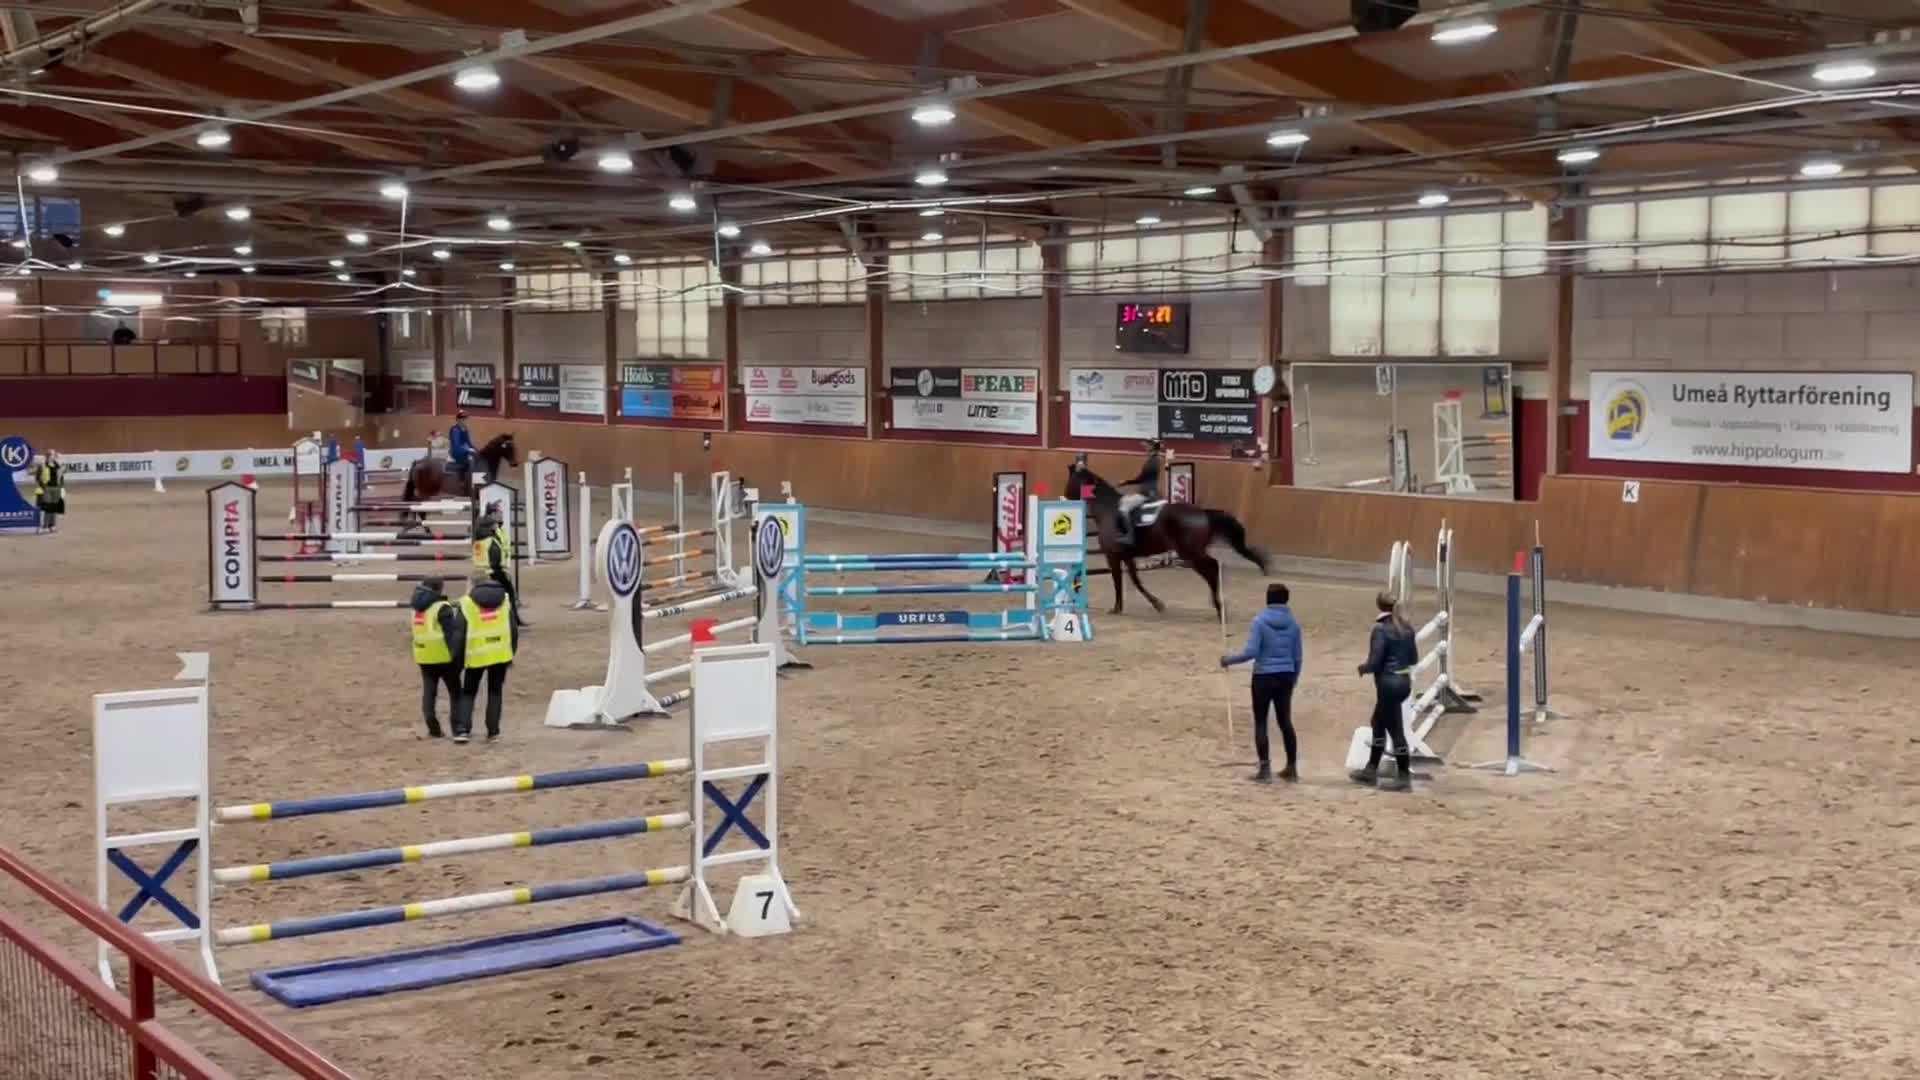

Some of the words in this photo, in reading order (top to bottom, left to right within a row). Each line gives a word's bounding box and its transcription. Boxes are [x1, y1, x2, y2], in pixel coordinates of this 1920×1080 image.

[973, 375, 1025, 393] PEAB
[1672, 382, 1728, 403] Umeå
[1733, 384, 1891, 412] Ryttarförening
[1624, 484, 1636, 499] K
[543, 470, 559, 543] COMPIA
[224, 499, 241, 590] COMPIA
[898, 613, 946, 623] URFUS
[1064, 619, 1075, 634] 4
[756, 890, 774, 920] 7
